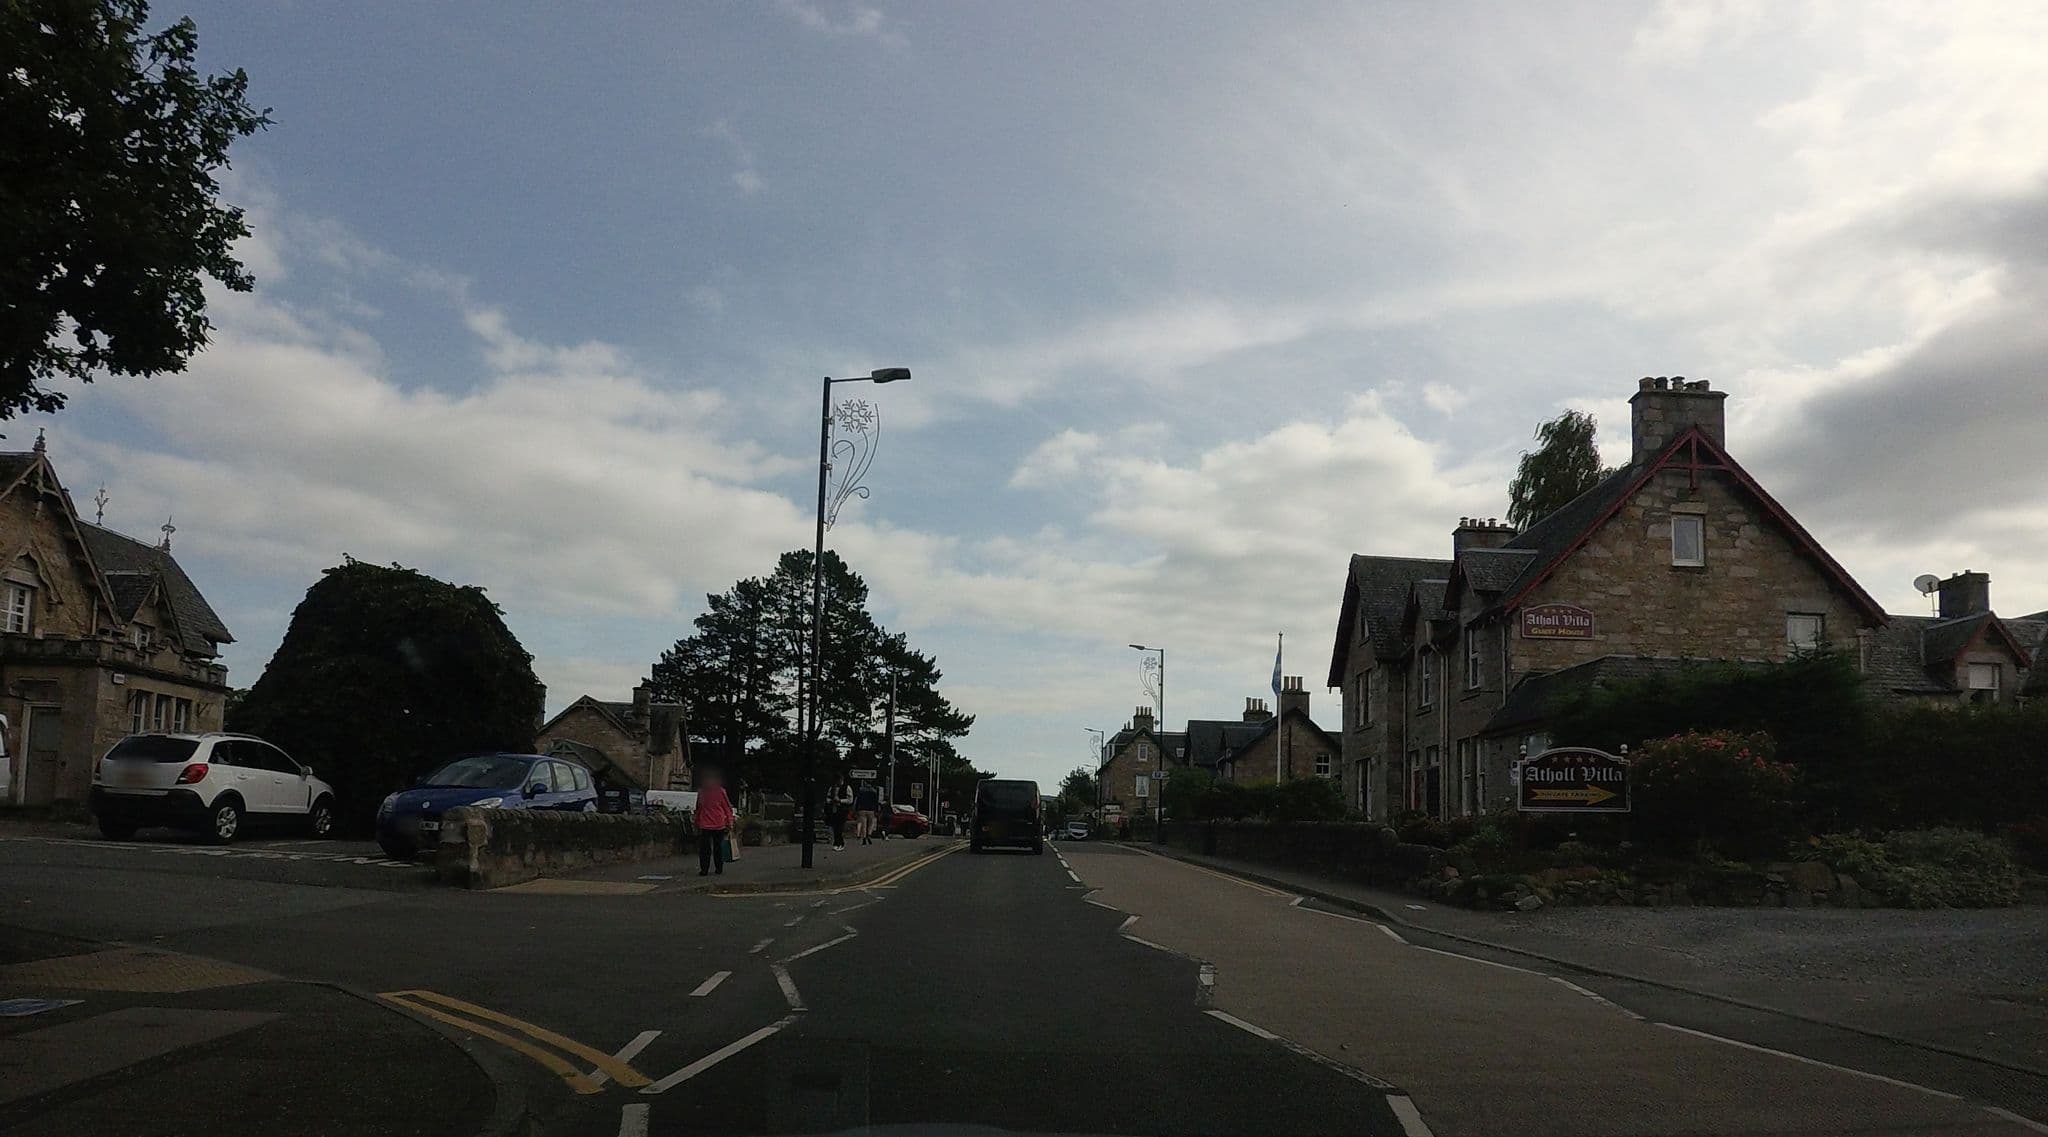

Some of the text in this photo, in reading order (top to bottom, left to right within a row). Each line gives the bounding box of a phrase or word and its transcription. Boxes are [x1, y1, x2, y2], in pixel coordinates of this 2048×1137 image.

[1526, 614, 1590, 626] Atholl Villa
[1526, 767, 1574, 783] Atholl
[1582, 767, 1623, 782] Villa
